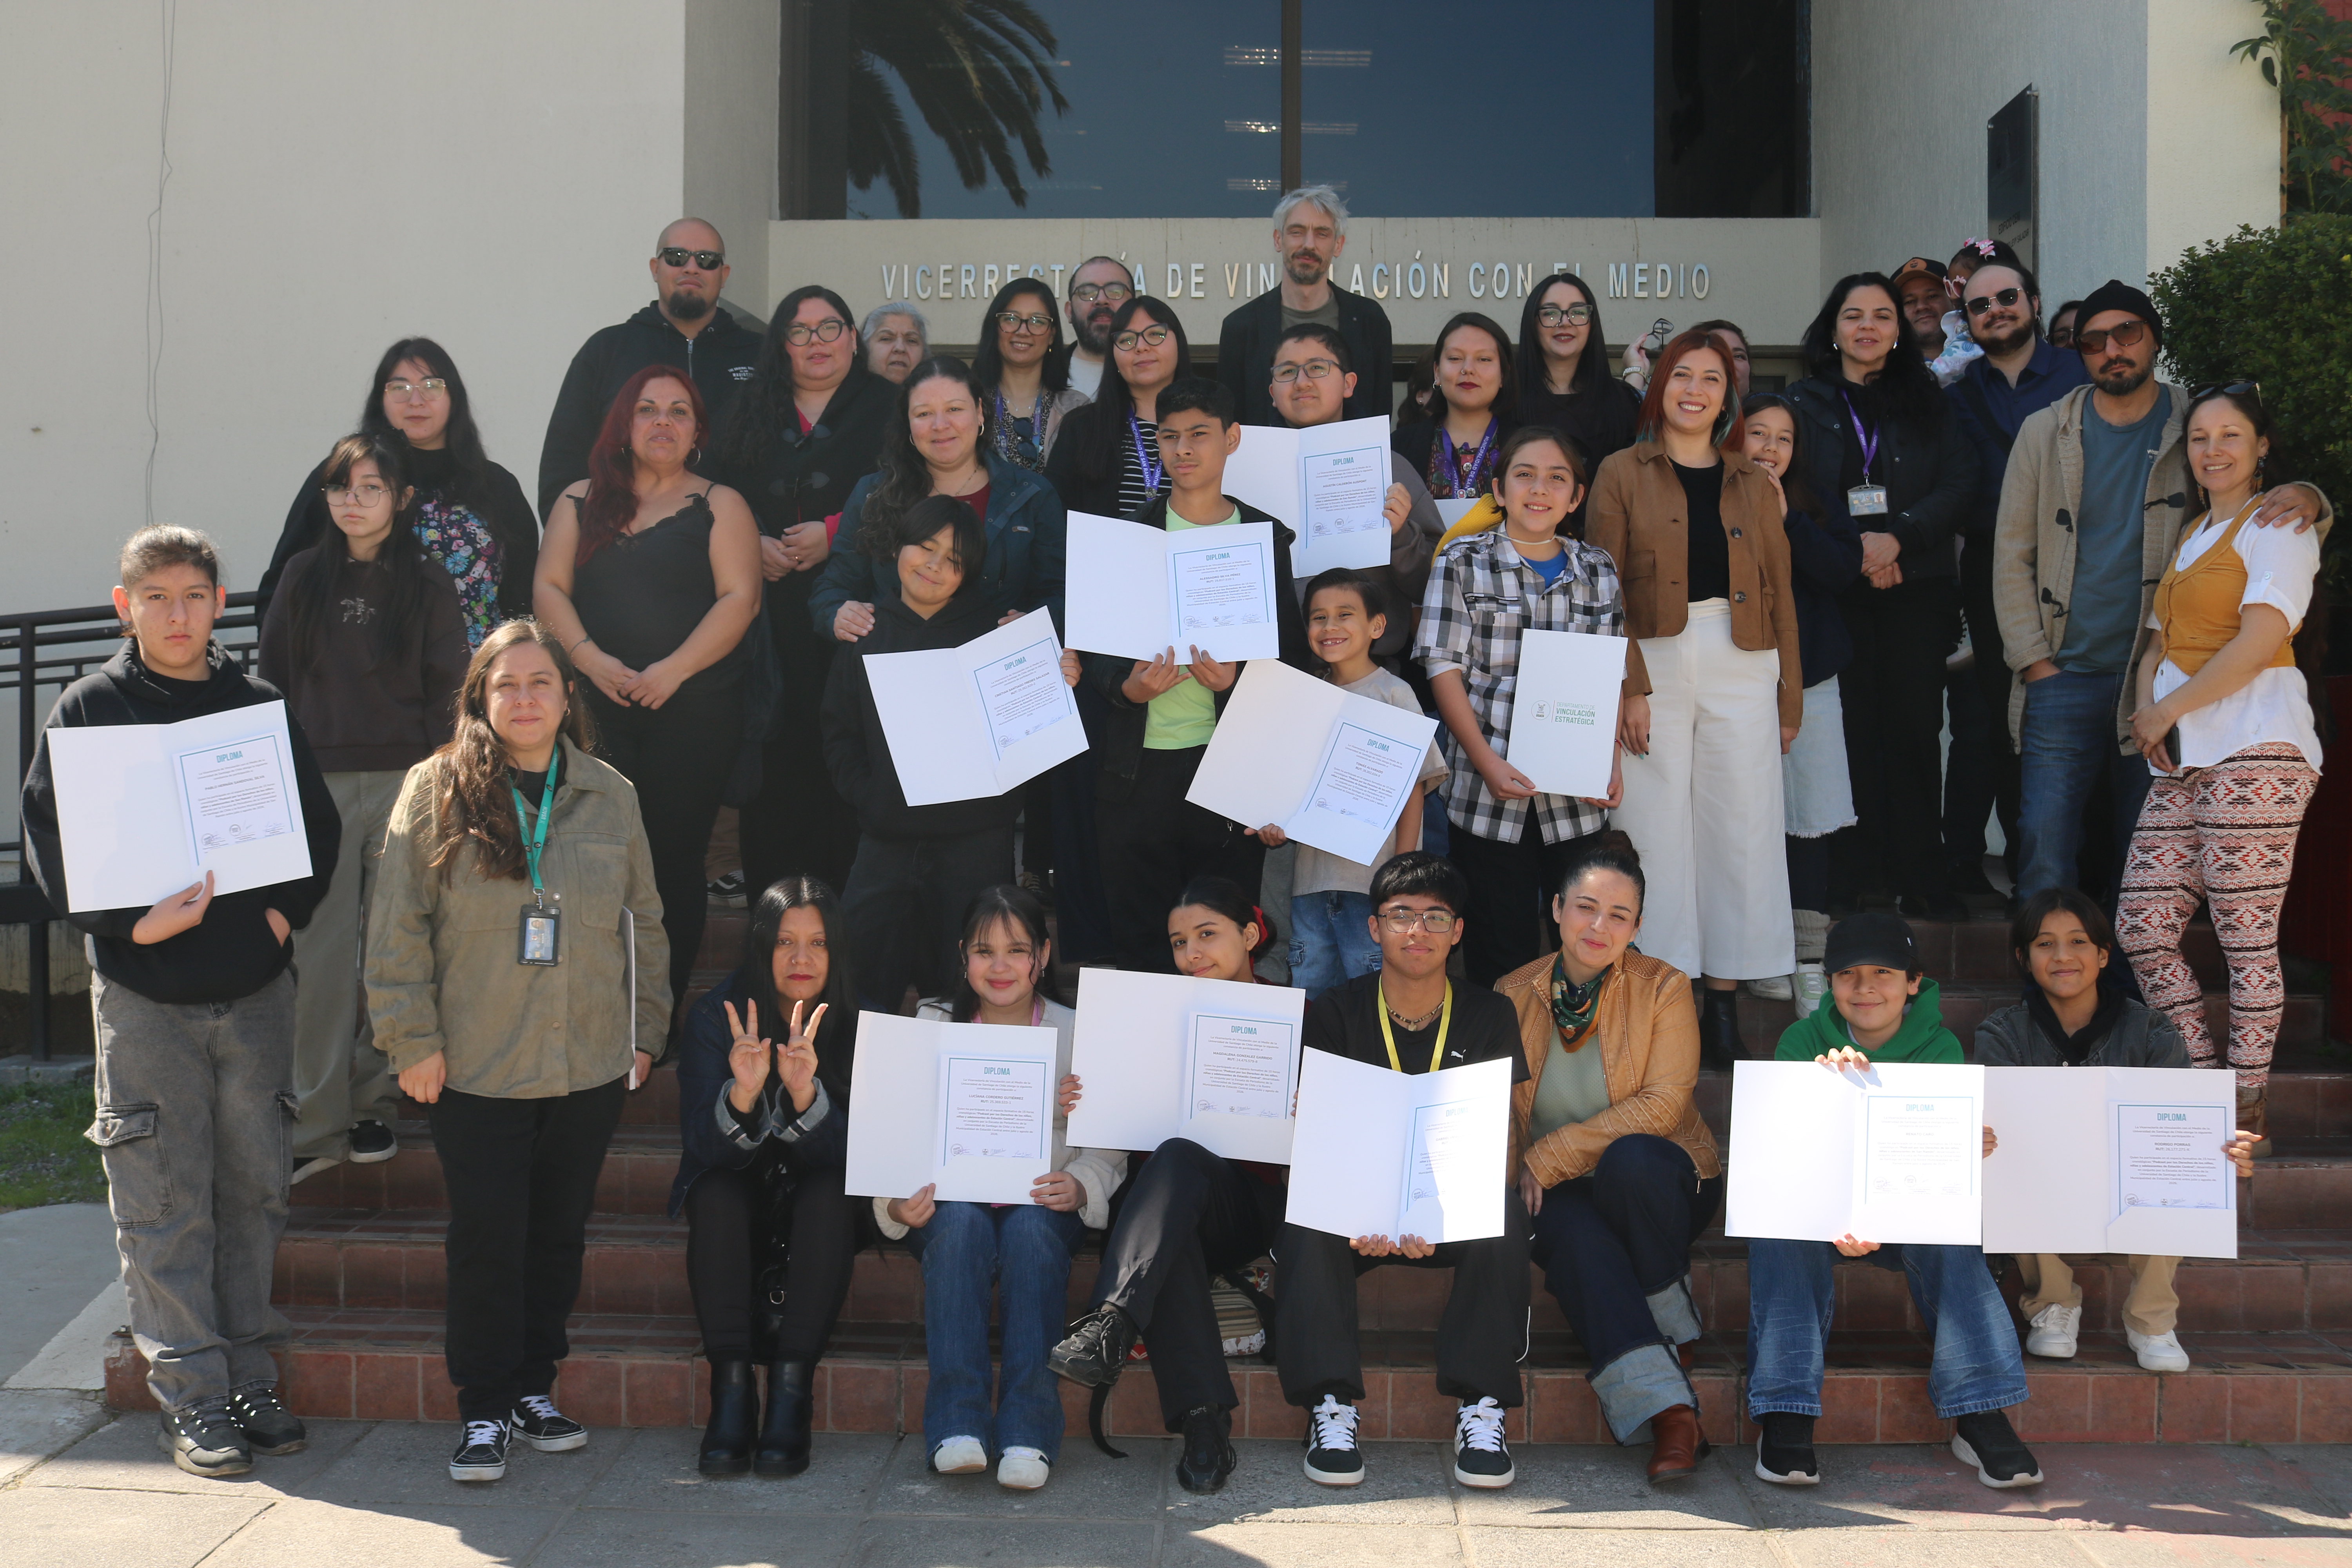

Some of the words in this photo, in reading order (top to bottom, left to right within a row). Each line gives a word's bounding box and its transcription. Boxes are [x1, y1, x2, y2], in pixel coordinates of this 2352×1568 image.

[2017, 229, 2029, 243] SALAZAR
[1167, 263, 1205, 298] DE
[1469, 262, 1532, 299] CON
[1609, 263, 1710, 299] MEDIO
[1472, 436, 1490, 470] MUNICIPALIDAD
[1333, 457, 1354, 465] DIPLOMA
[1143, 468, 1151, 487] RAMÓN
[1206, 552, 1230, 561] DIPLOMA
[1004, 655, 1026, 671] DIPLOMA
[995, 690, 1008, 698] CRISTIAN
[1009, 683, 1024, 691] SANTIAGO
[1036, 671, 1049, 680] SALAZAR
[1556, 708, 1595, 717] VINCULACIÓN
[1555, 716, 1594, 726] ESTRATÉGICA
[1367, 739, 1390, 752] DIPLOMA
[216, 750, 243, 763] DIPLOMA
[1367, 766, 1383, 774] ALVARADO
[1231, 1025, 1257, 1035] DIPLOMA
[984, 1067, 1010, 1075] DIPLOMA
[1446, 1107, 1468, 1116] DIPLOMA
